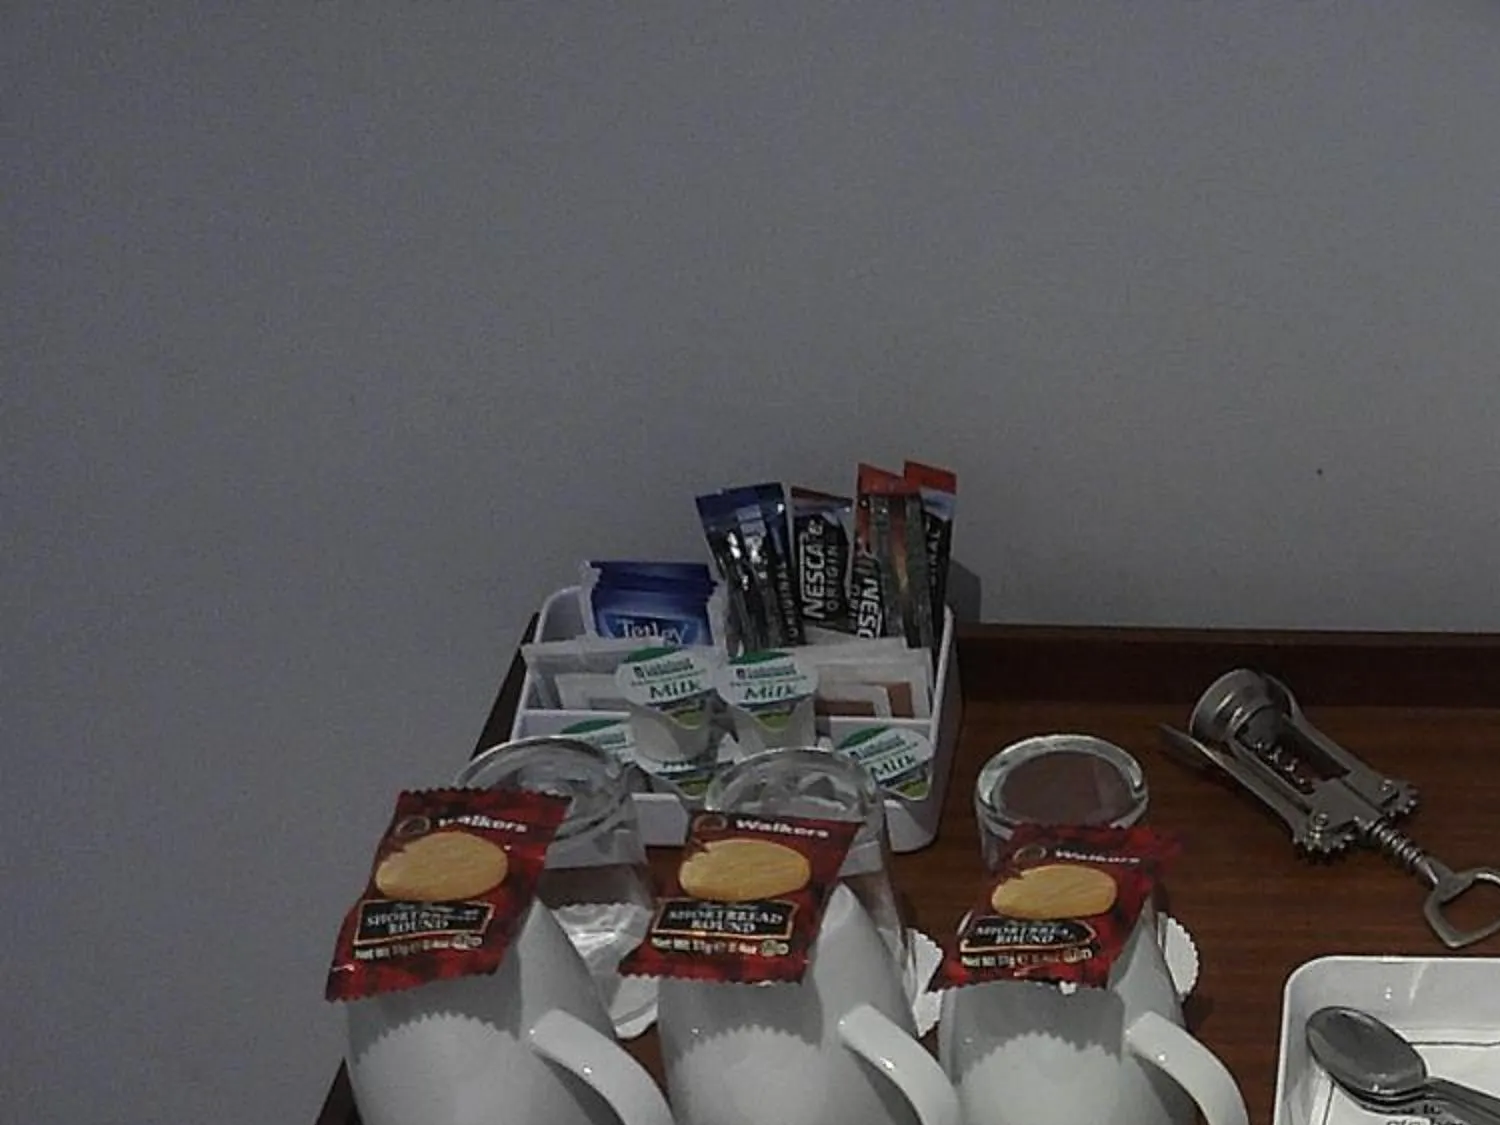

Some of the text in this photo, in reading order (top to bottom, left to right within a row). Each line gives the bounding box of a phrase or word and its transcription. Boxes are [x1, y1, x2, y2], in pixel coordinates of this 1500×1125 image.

[650, 680, 701, 699] Milk
[745, 684, 798, 701] Milk
[871, 755, 916, 779] Milk
[736, 818, 829, 838] Walkers
